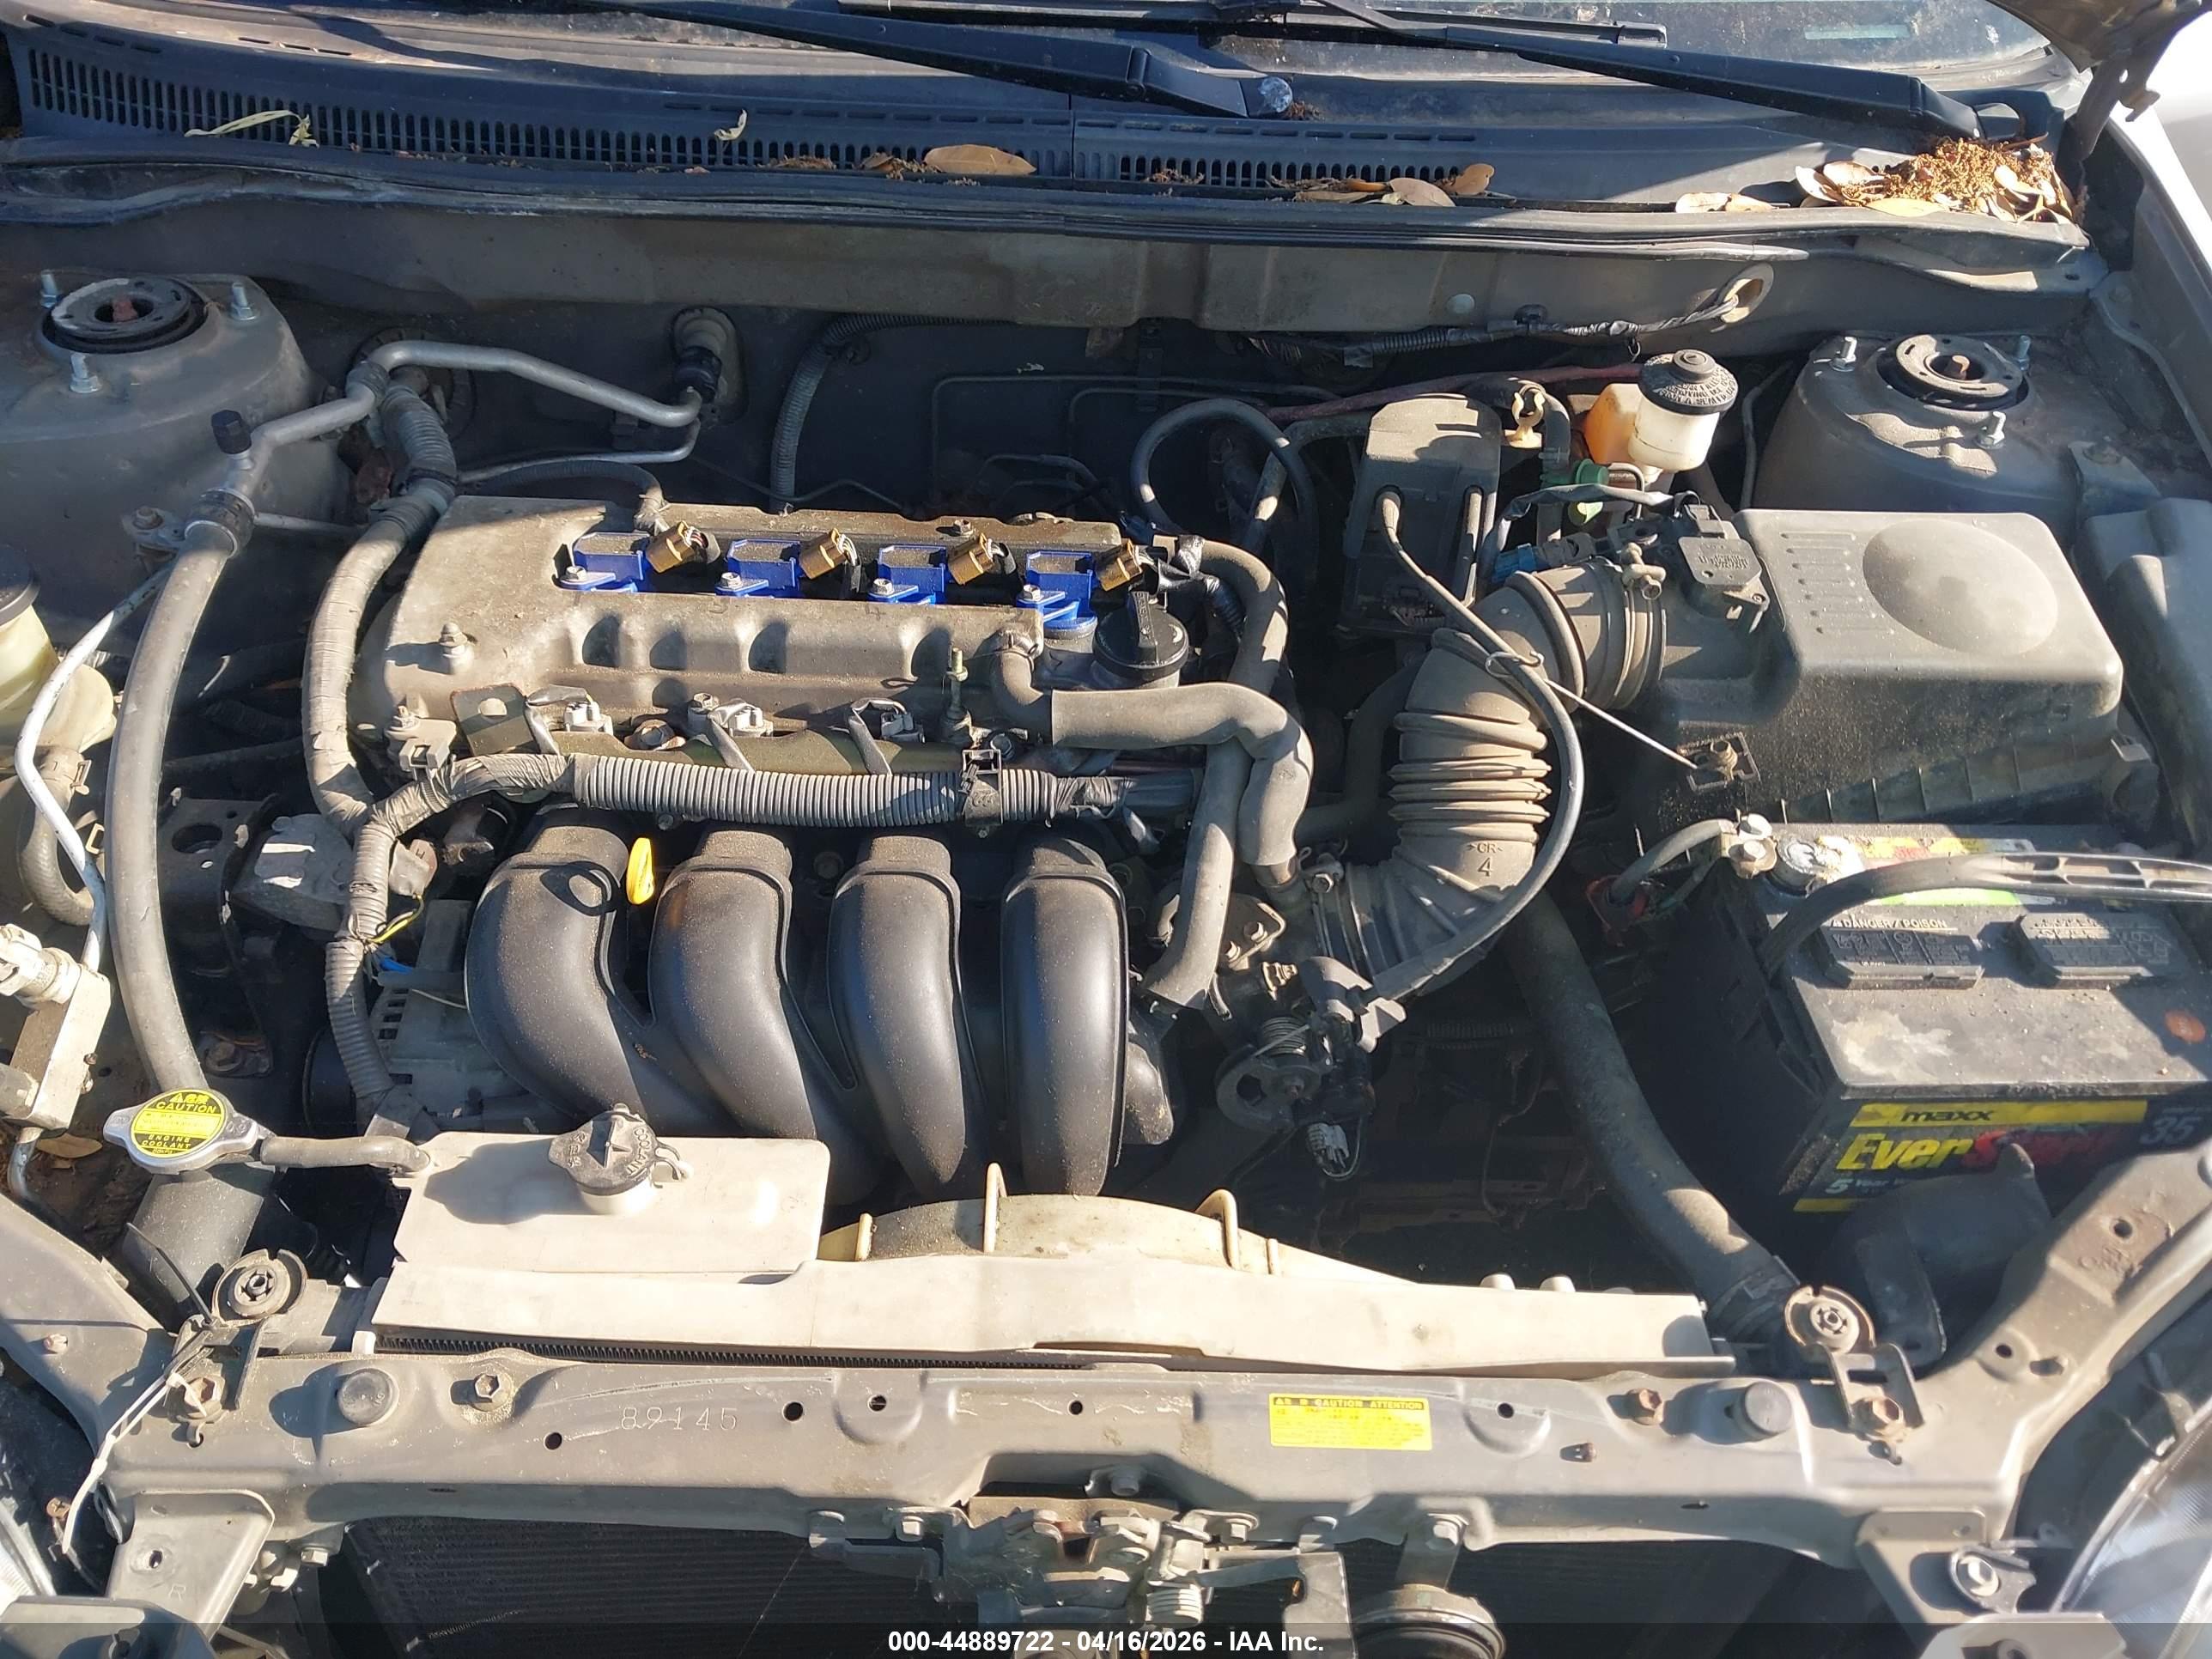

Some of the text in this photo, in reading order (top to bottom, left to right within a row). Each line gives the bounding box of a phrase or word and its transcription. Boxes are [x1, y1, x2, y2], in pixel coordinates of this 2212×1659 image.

[1478, 857, 1492, 877] 4
[155, 1101, 216, 1114] CAUTION
[1901, 1110, 1995, 1121] maxx
[2140, 1115, 2202, 1145] 35
[142, 1139, 191, 1149] COOLANT
[148, 1133, 191, 1143] ENGINE
[627, 1127, 651, 1176] COOLANT
[1825, 1178, 1855, 1194] 5
[1314, 1398, 1364, 1408] CAUTION
[1370, 1400, 1423, 1410] ATTENTION
[621, 1407, 737, 1431] 89145
